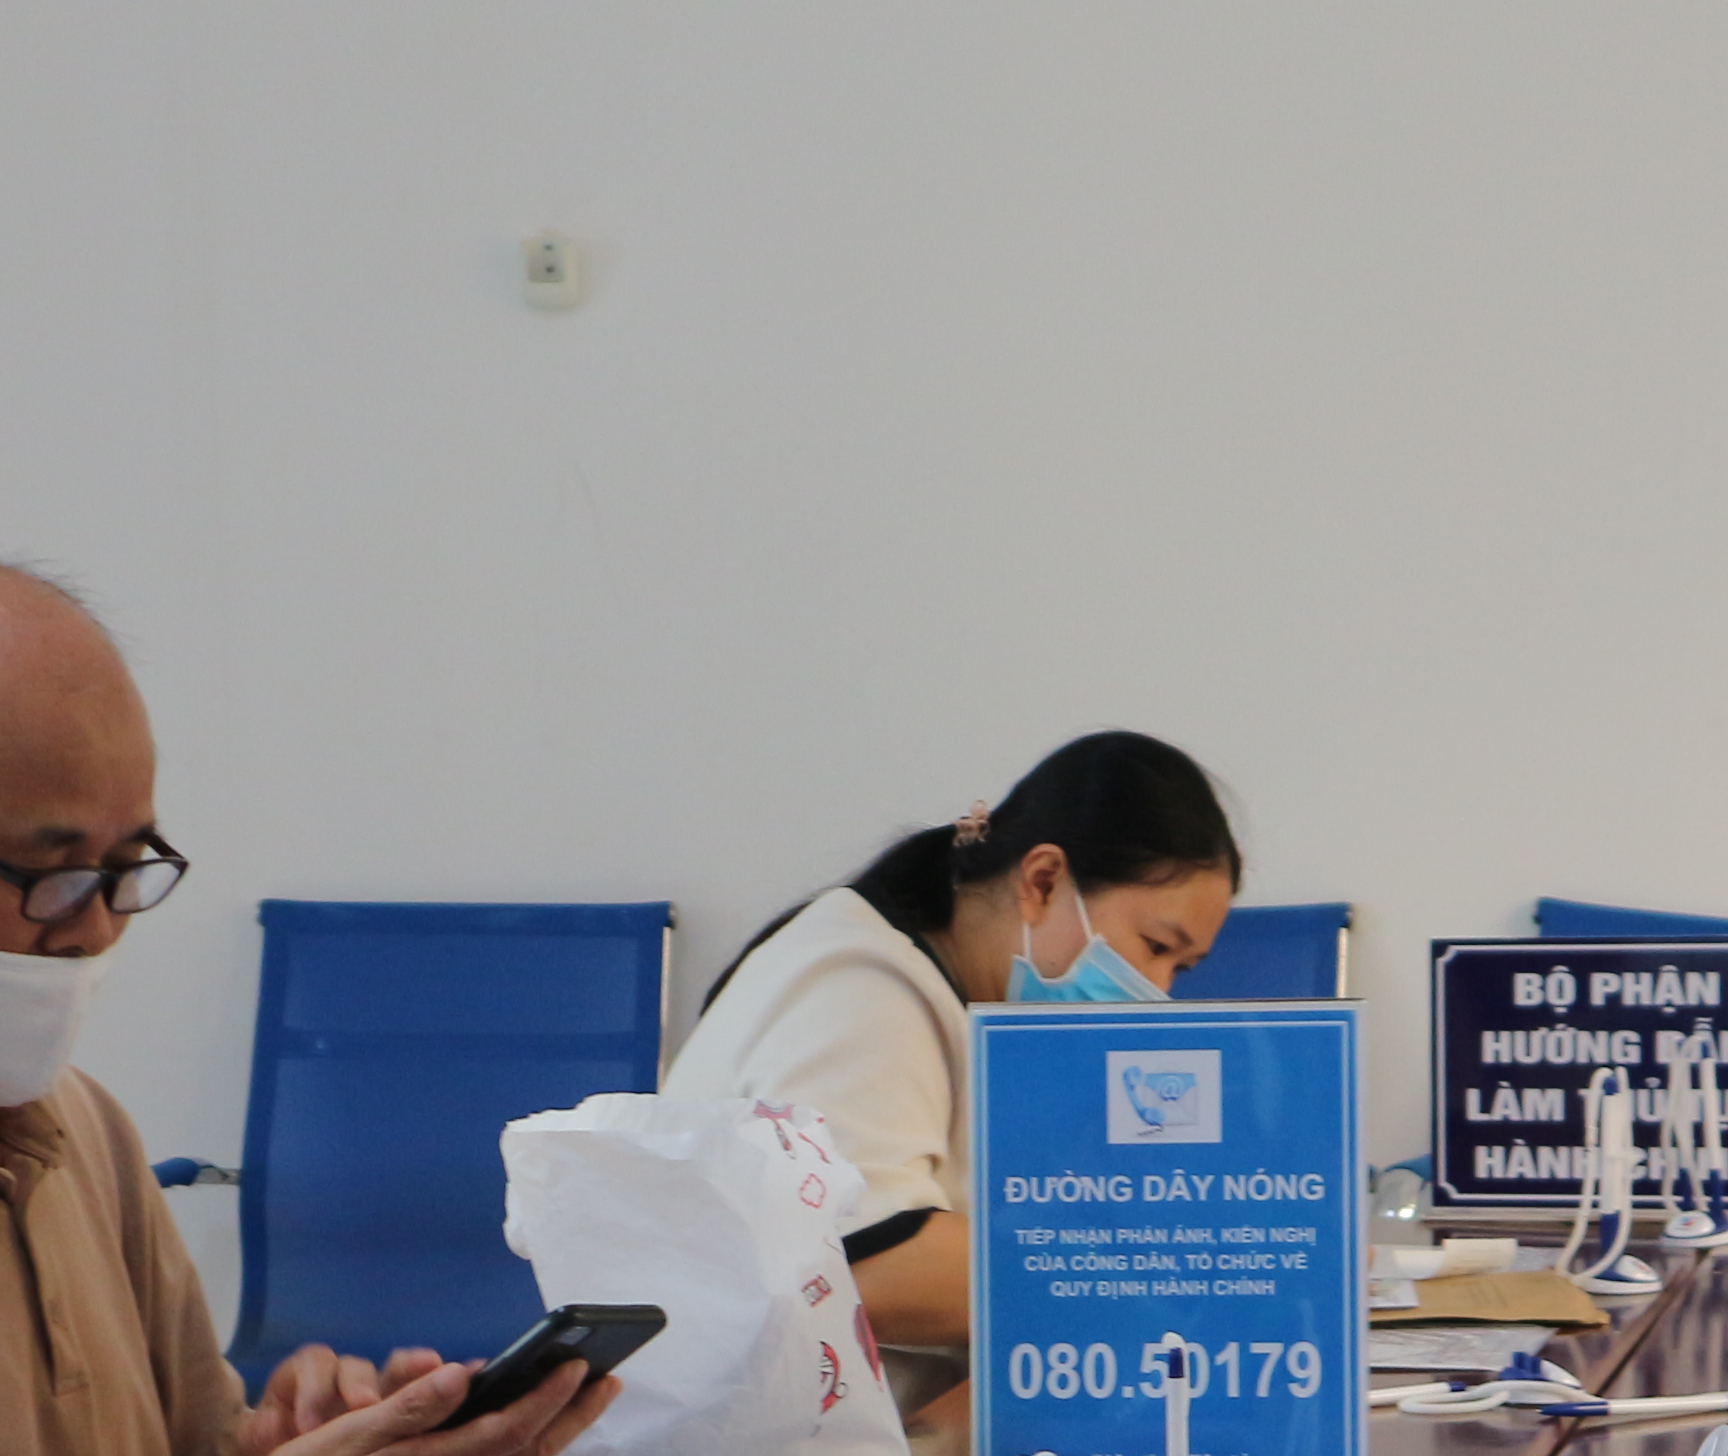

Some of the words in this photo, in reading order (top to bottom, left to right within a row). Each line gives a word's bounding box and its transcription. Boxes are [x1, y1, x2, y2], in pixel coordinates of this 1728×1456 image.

[1512, 965, 1576, 1014] BỘ
[1589, 965, 1721, 1014] PHẬN
[1481, 1023, 1642, 1065] HƯỚNG
[1465, 1081, 1566, 1123] LÀM
[1003, 1169, 1133, 1203] ĐƯỜNG
[1143, 1168, 1215, 1202] DÂY
[1223, 1167, 1326, 1201] NÓNG
[1014, 1226, 1056, 1245] TIẾP
[1059, 1226, 1112, 1248] NHẬN
[1116, 1225, 1169, 1245] PHẢN
[1221, 1225, 1266, 1244] KIẾN
[1269, 1226, 1317, 1247] NGHỊ
[1024, 1252, 1067, 1272] CỦA
[1070, 1251, 1129, 1272] CÔNG
[1132, 1251, 1181, 1273] DÂN,
[1184, 1251, 1214, 1271] TỔ
[1216, 1250, 1277, 1271] CHỨC
[1280, 1250, 1309, 1270] VỀ
[1049, 1280, 1093, 1298] QUY
[1096, 1280, 1148, 1300] ĐỊNH
[1152, 1276, 1210, 1296] HÀNH
[1213, 1276, 1276, 1296] CHÍNH
[1009, 1341, 1323, 1400] 080.50179
